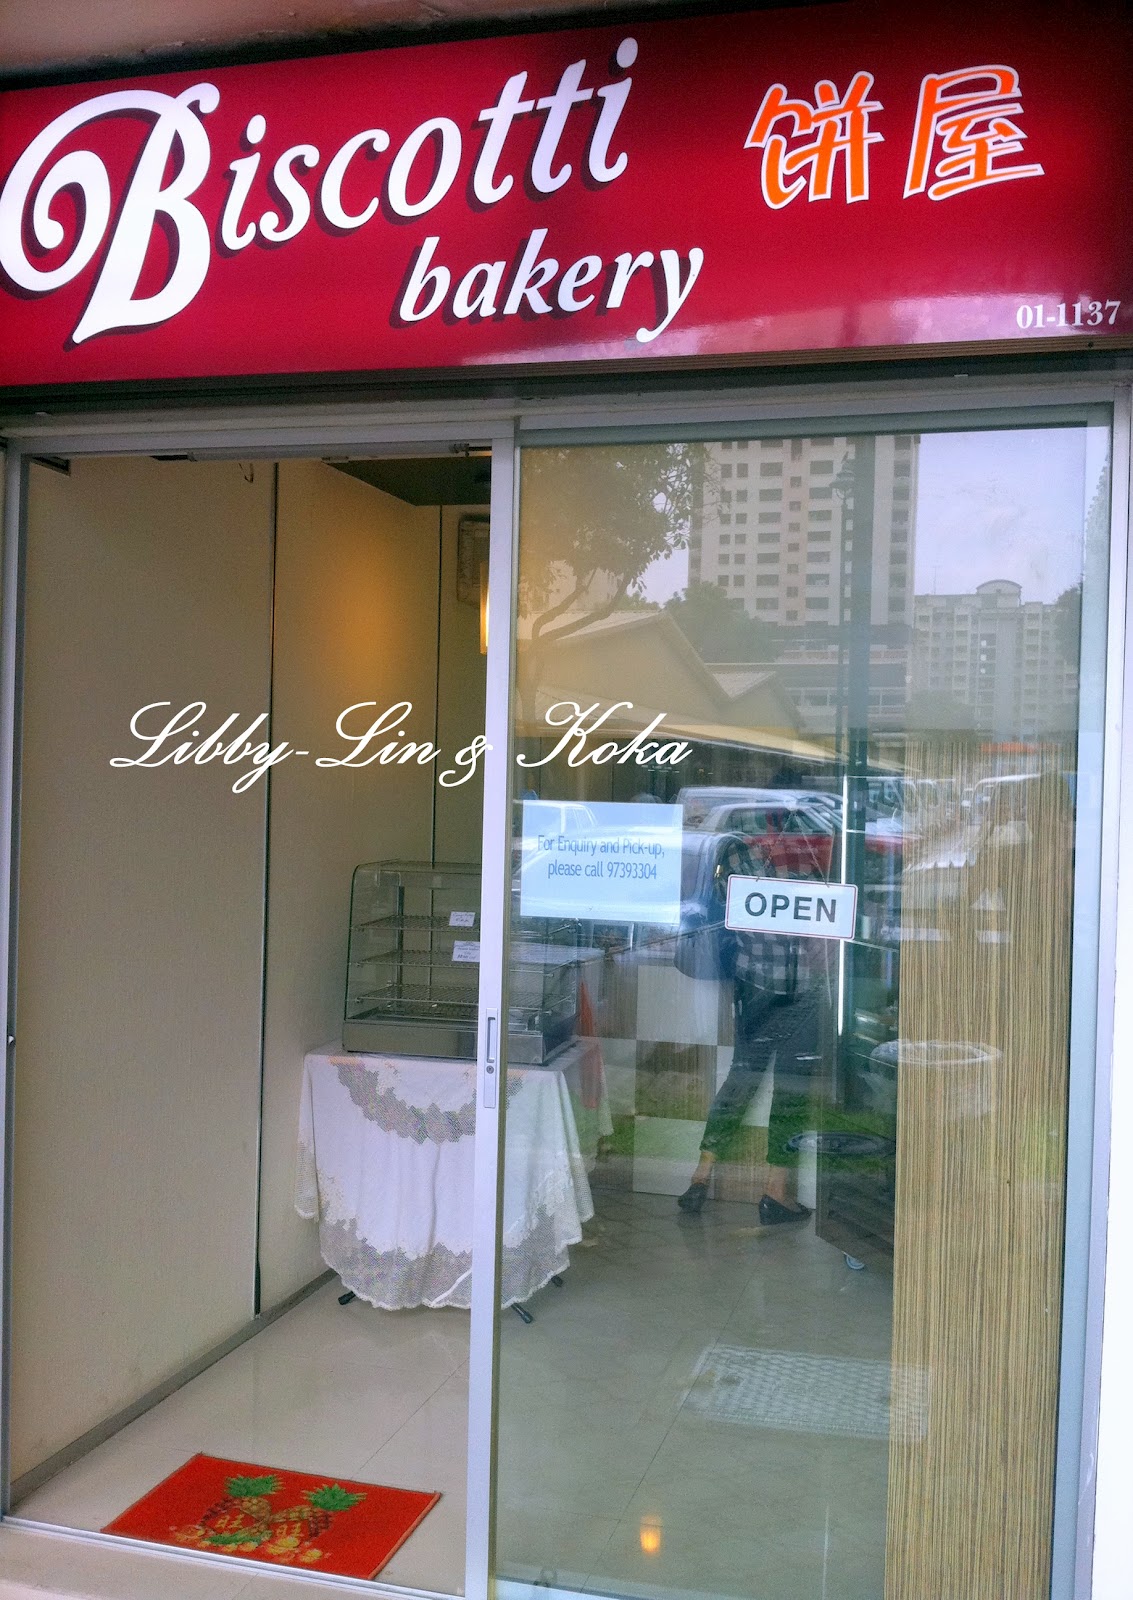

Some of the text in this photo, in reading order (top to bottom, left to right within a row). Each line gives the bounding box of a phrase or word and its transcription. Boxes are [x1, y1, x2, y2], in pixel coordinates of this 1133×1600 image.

[743, 64, 1046, 210] 饼屋
[0, 37, 639, 345] Biscotti
[399, 228, 704, 343] bakery
[1016, 299, 1122, 329] 01-1137
[537, 834, 665, 859] For Enquiry and Pick-up,
[547, 859, 657, 880] please call 97393304
[744, 891, 837, 923] OPEN
